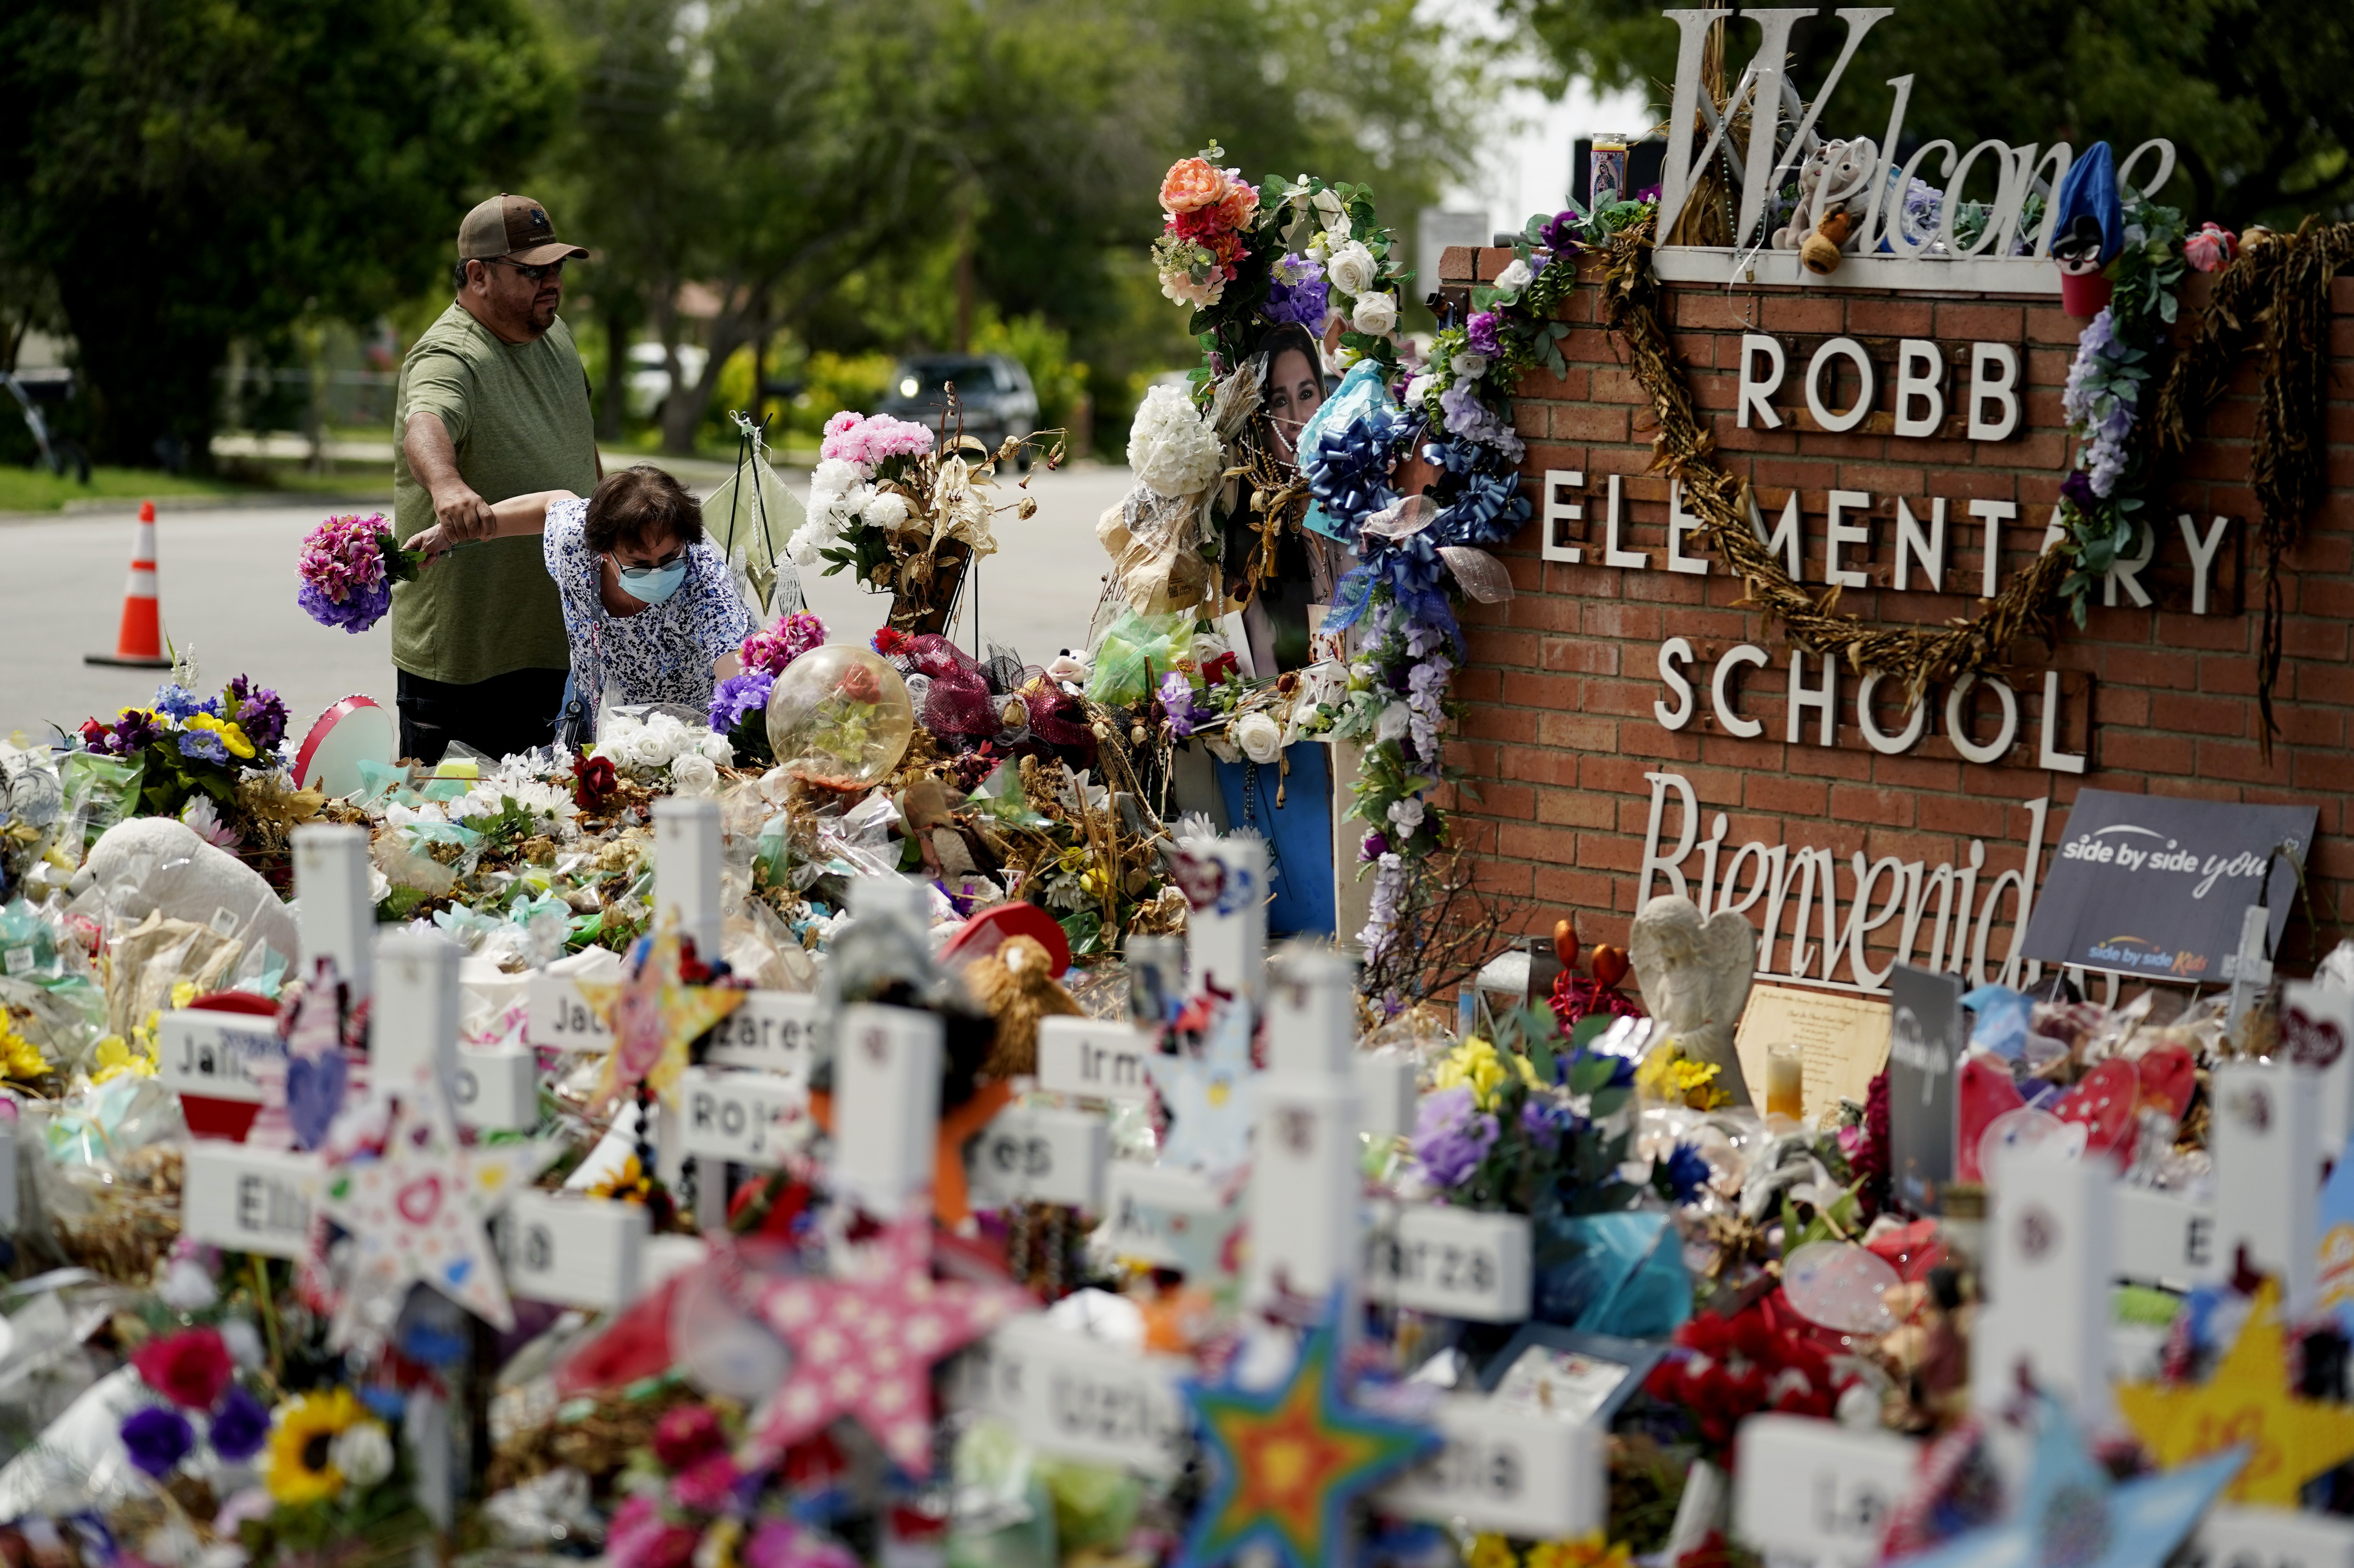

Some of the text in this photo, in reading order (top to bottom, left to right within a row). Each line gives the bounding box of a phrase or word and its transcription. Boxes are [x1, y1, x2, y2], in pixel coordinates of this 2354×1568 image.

[1737, 333, 2021, 441] ROBB
[1542, 469, 2228, 614] ELEMENTRY
[1654, 636, 2086, 773] SCHOOL
[1635, 772, 2120, 1009] Bienvenid
[2062, 833, 2267, 899] side by side you
[2088, 941, 2208, 976] side by side Kids
